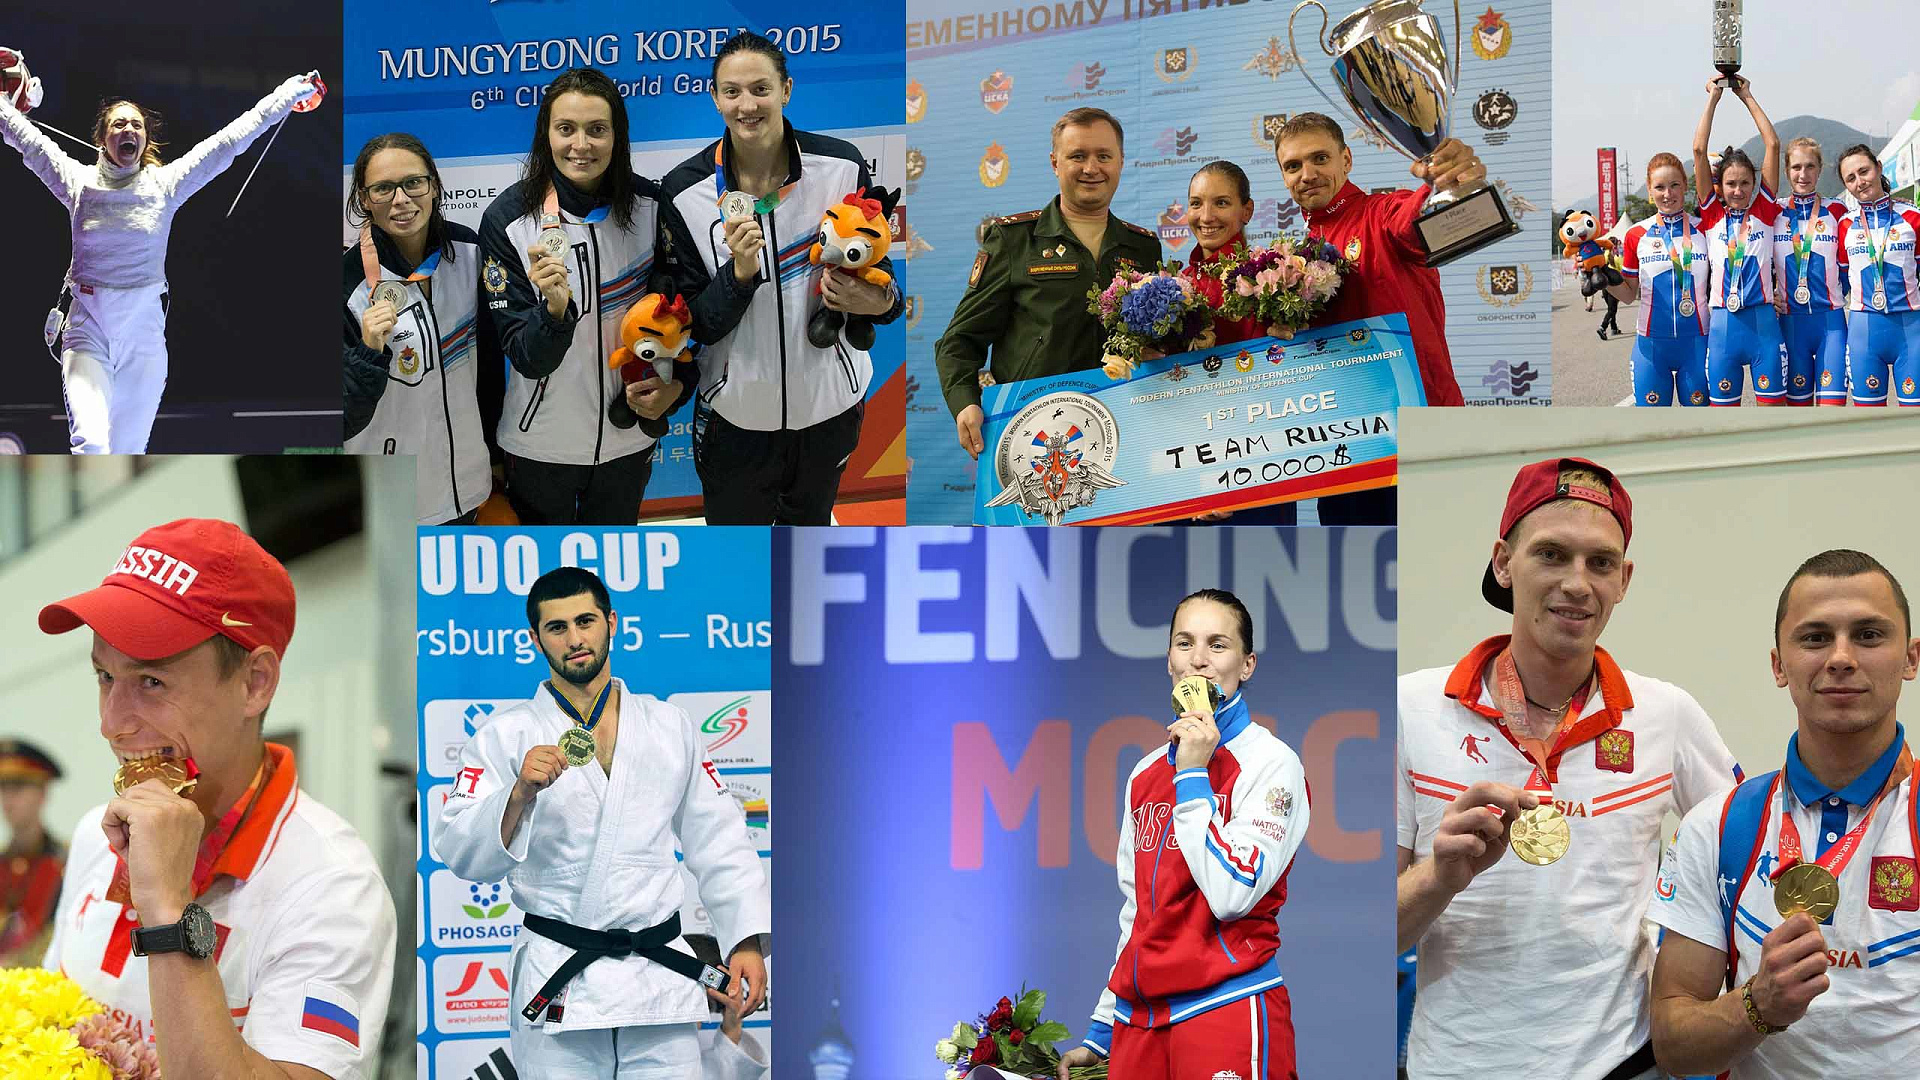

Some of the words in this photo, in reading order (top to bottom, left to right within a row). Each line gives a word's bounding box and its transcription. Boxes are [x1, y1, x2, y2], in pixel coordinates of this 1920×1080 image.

[378, 33, 620, 80] MUNGYEONG
[634, 28, 748, 62] KORE
[471, 86, 504, 110] 6th
[613, 75, 662, 98] orld
[442, 202, 479, 210] TDOOR
[443, 187, 497, 200] NPOLE
[1815, 234, 1838, 243] ARMY
[1889, 242, 1914, 252] ARMY
[1477, 312, 1536, 322] ОБОРОНСТРОЙ
[1130, 389, 1174, 405] MODERN
[1177, 378, 1243, 397] PENTATHLON
[1246, 362, 1327, 384] INTERNATIONAL
[1330, 348, 1404, 368] TOURNAMENT
[1247, 390, 1338, 423] PLACE
[1465, 397, 1552, 408] идроПромСтр
[1166, 434, 1270, 469] TEAM
[1285, 415, 1390, 447] RUSSIA
[420, 535, 540, 595] UDO
[560, 531, 680, 592] CUP
[790, 526, 1397, 666] FENCING
[707, 614, 771, 650] Rus
[1259, 828, 1285, 843] TEAM
[1827, 949, 1862, 969] SIA
